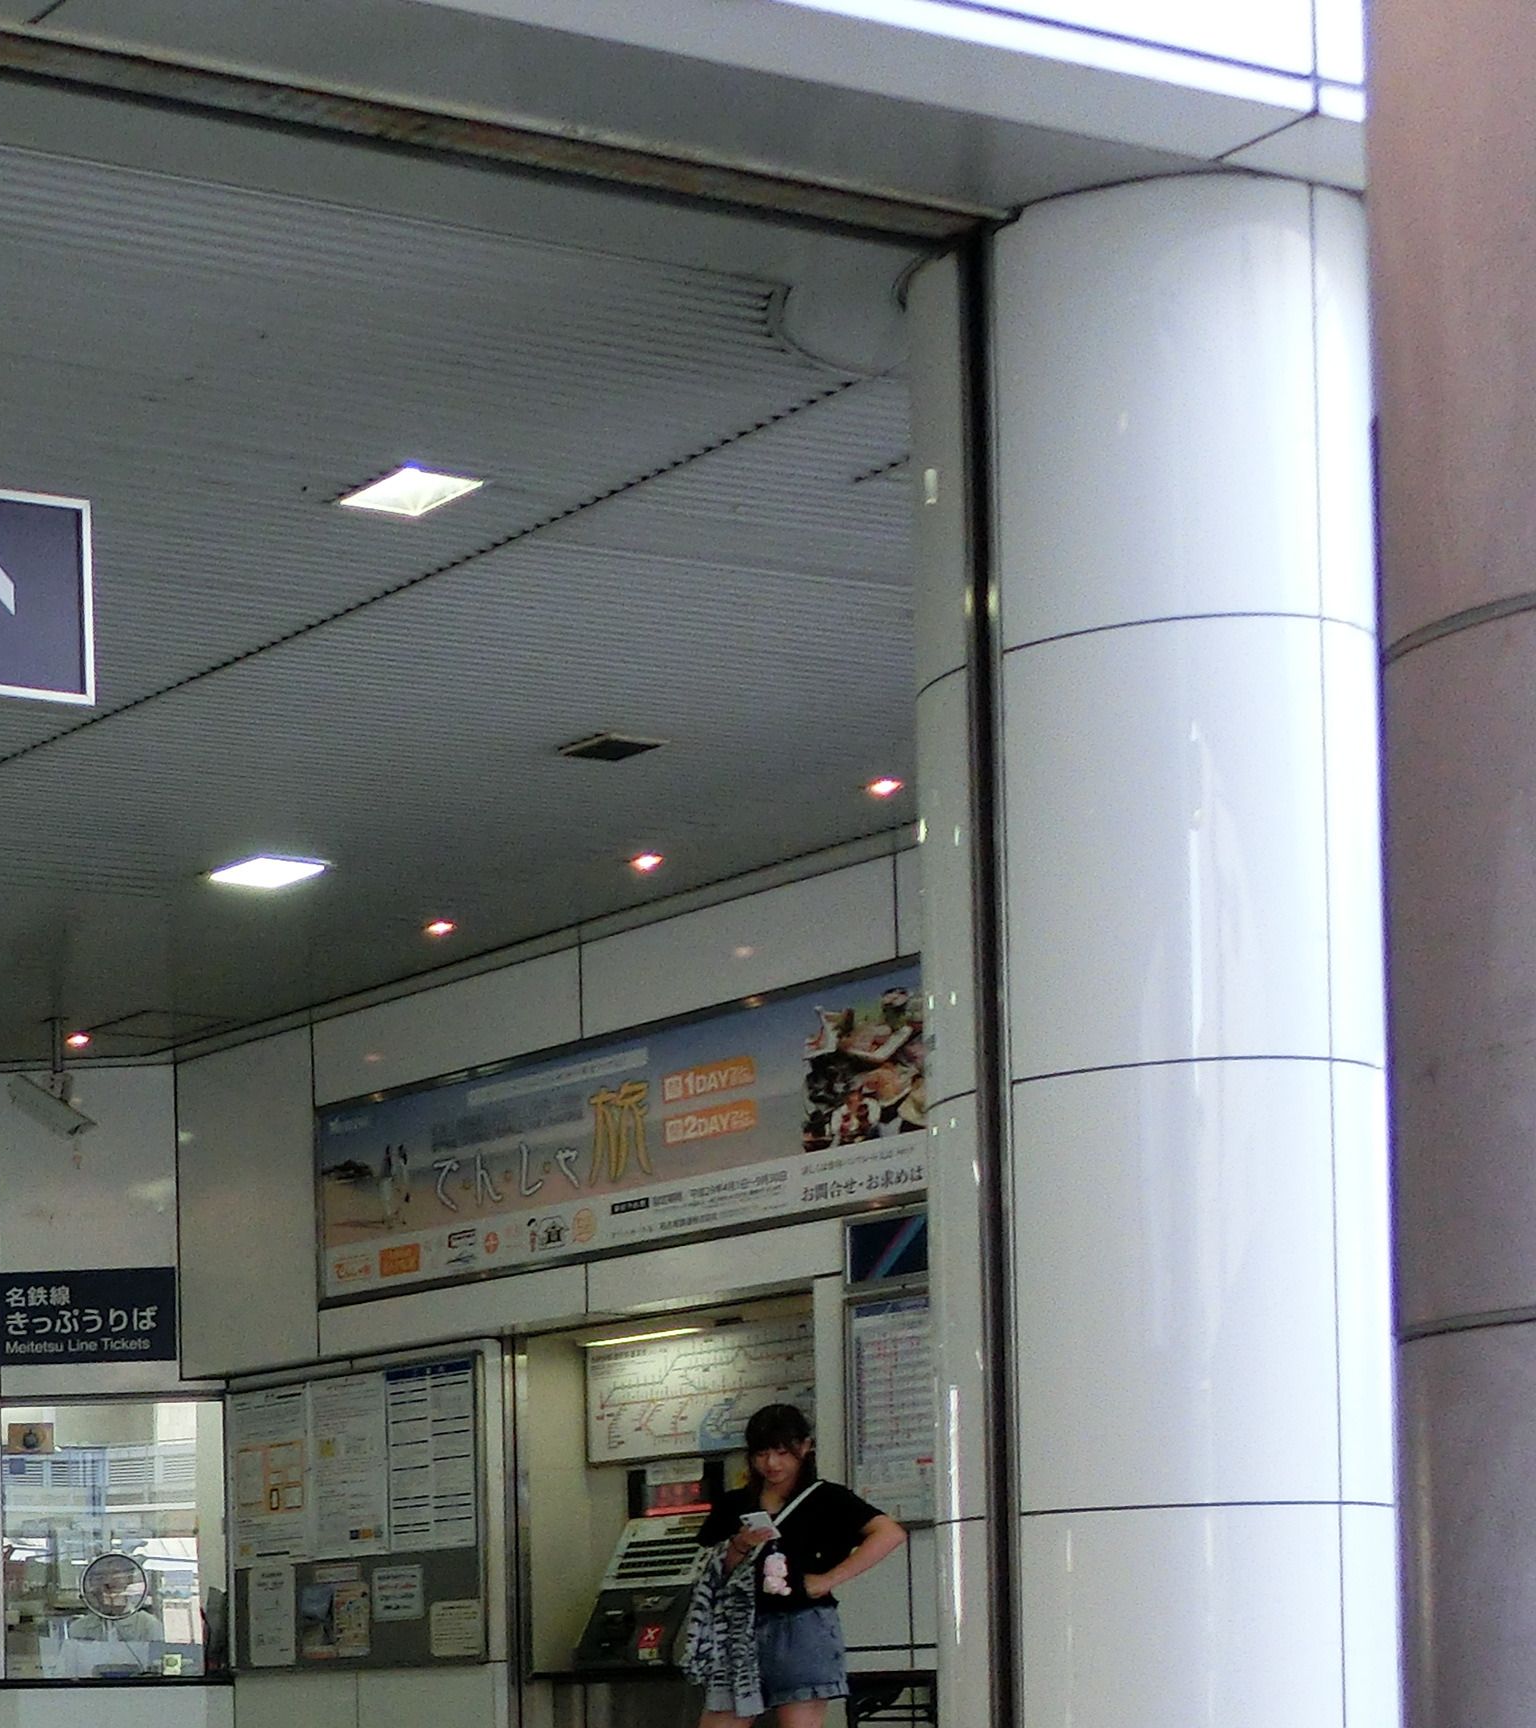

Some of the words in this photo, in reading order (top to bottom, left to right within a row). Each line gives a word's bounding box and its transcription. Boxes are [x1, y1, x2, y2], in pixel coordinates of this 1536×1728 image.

[5, 1285, 71, 1308] 名鉄線
[5, 1305, 159, 1336] きっぷうりば
[5, 1339, 64, 1355] Meitetsu
[68, 1337, 98, 1353] Line
[100, 1336, 151, 1352] Tickets
